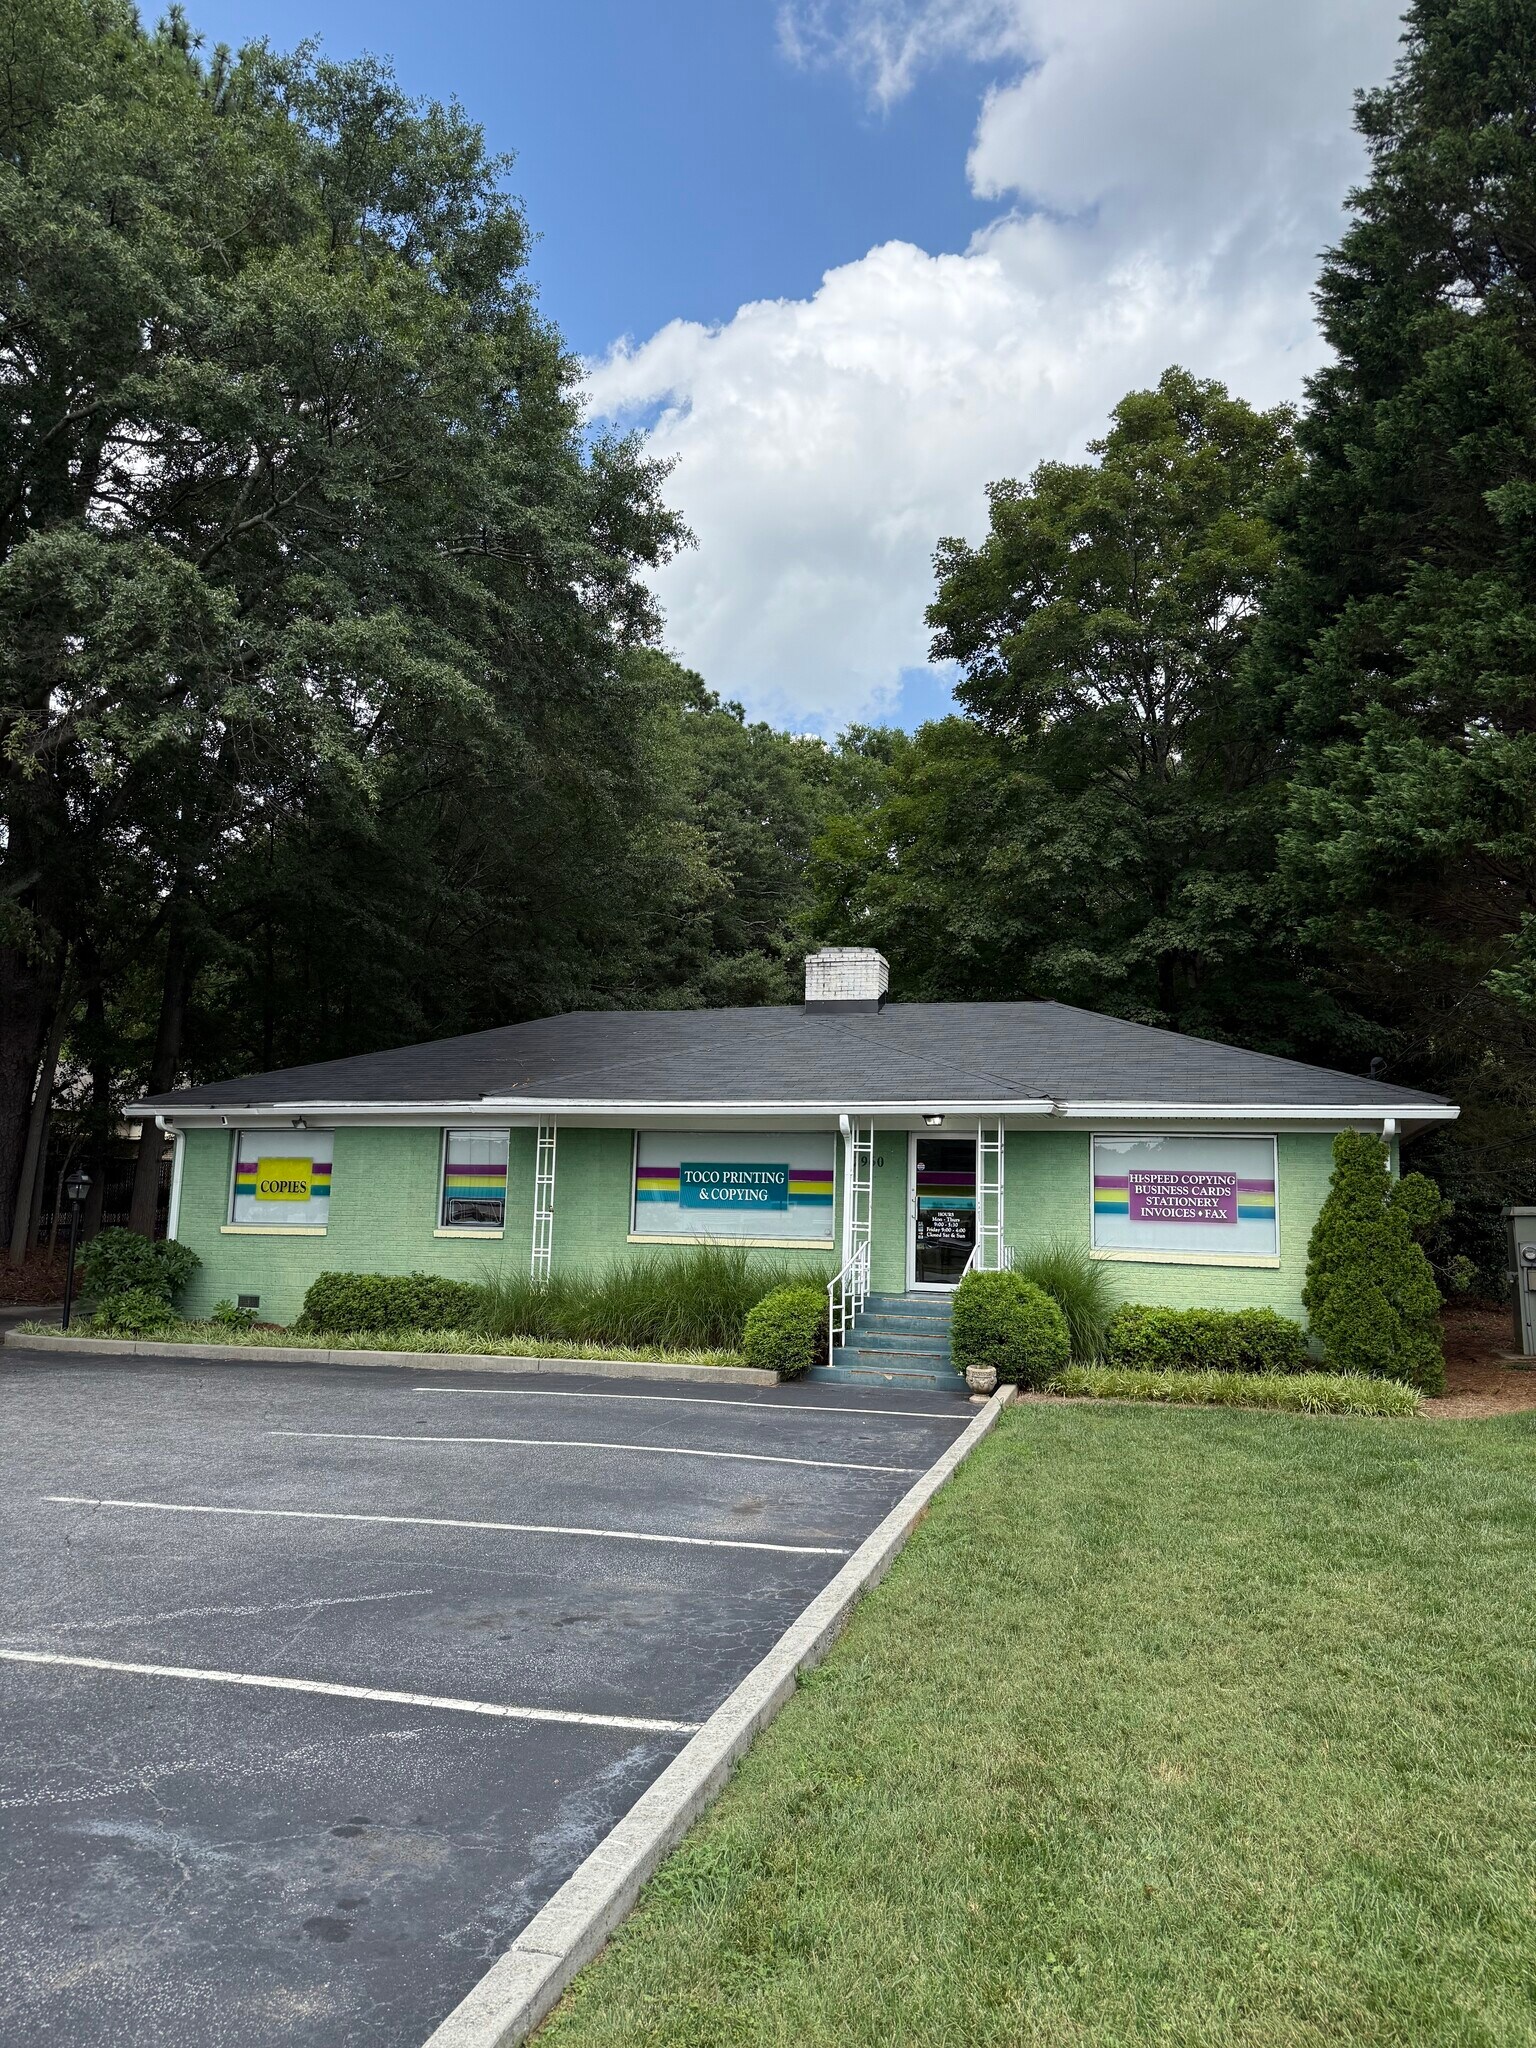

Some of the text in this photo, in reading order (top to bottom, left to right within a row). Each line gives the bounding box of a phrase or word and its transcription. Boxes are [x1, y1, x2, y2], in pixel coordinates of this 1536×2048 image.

[684, 1170, 785, 1184] TOCO PRINTING
[1129, 1174, 1236, 1185] HI-SPEED COPYING
[260, 1180, 307, 1194] COPIES
[1134, 1184, 1232, 1196] BUSINESS CARDS
[699, 1188, 768, 1202] & COPYING
[1146, 1196, 1220, 1208] STATIONERY
[1140, 1207, 1228, 1219] INVOICES FAX
